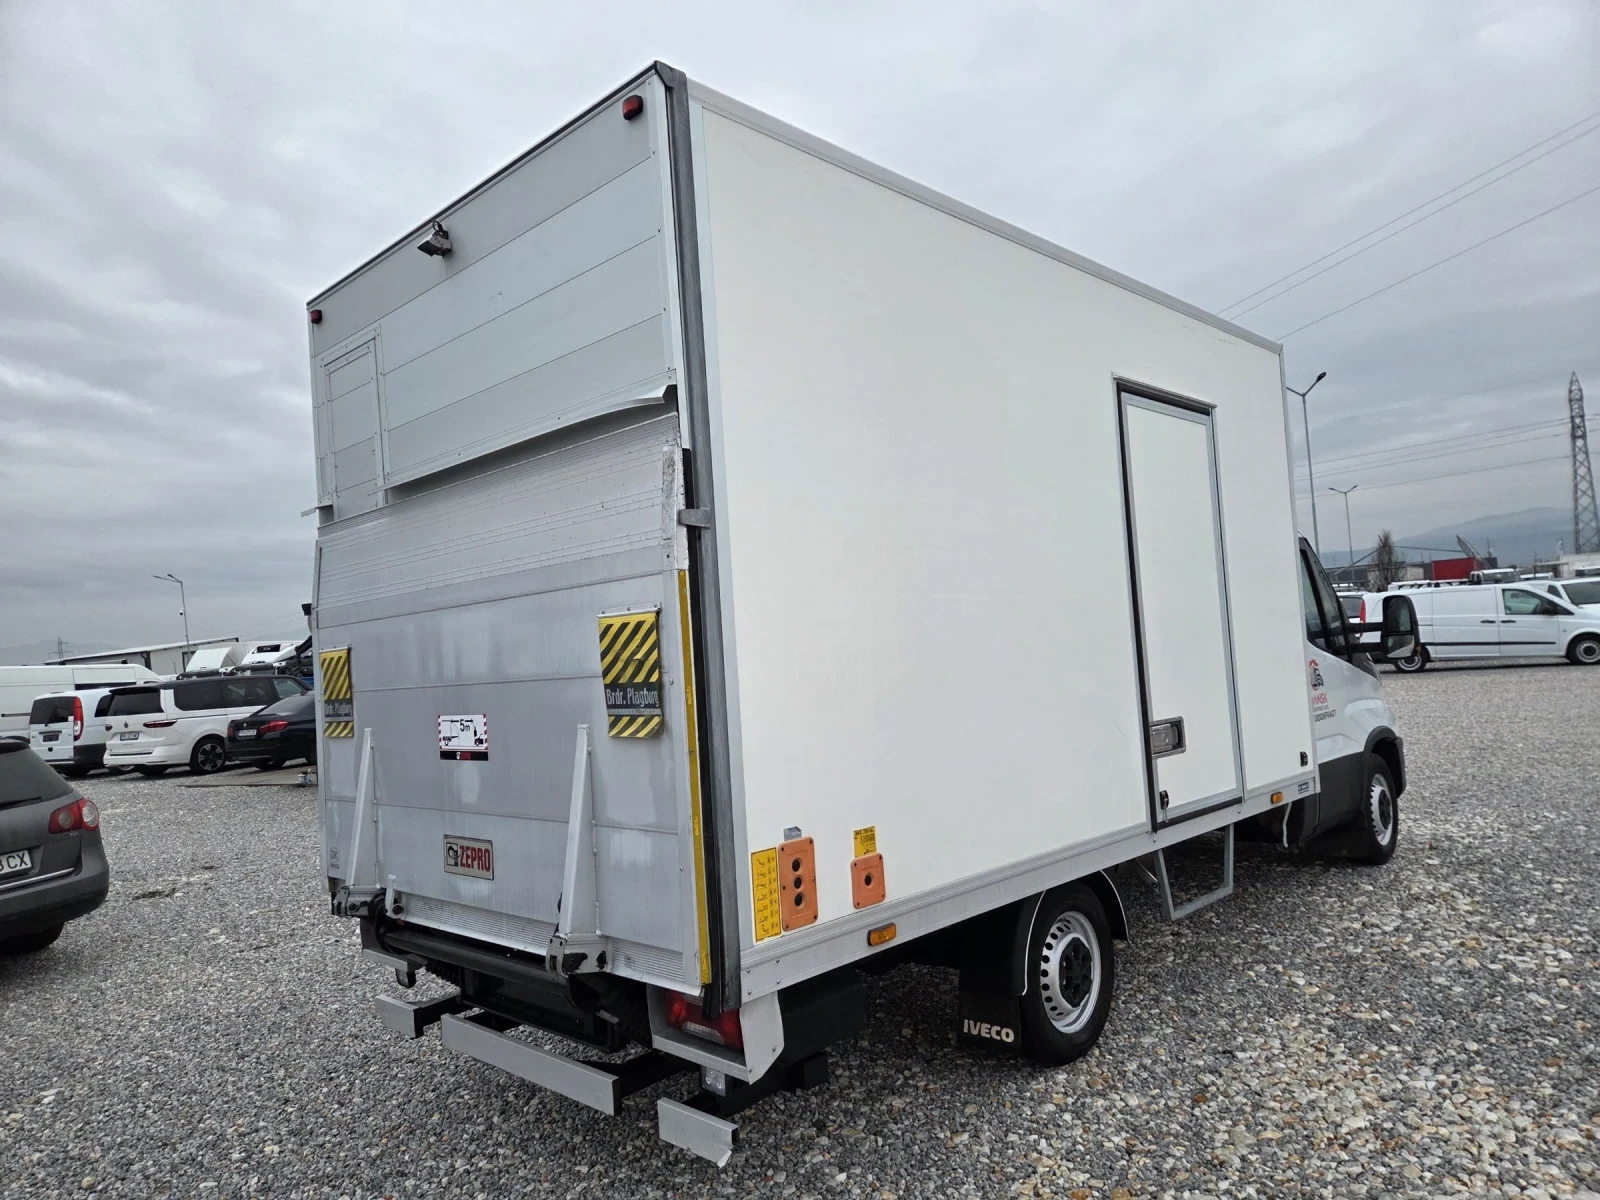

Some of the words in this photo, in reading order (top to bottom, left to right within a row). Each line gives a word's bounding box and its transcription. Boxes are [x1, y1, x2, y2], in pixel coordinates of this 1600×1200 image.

[606, 688, 626, 705] Brdr.
[459, 844, 491, 872] ZEPRO
[963, 1019, 1015, 1043] IVECO
